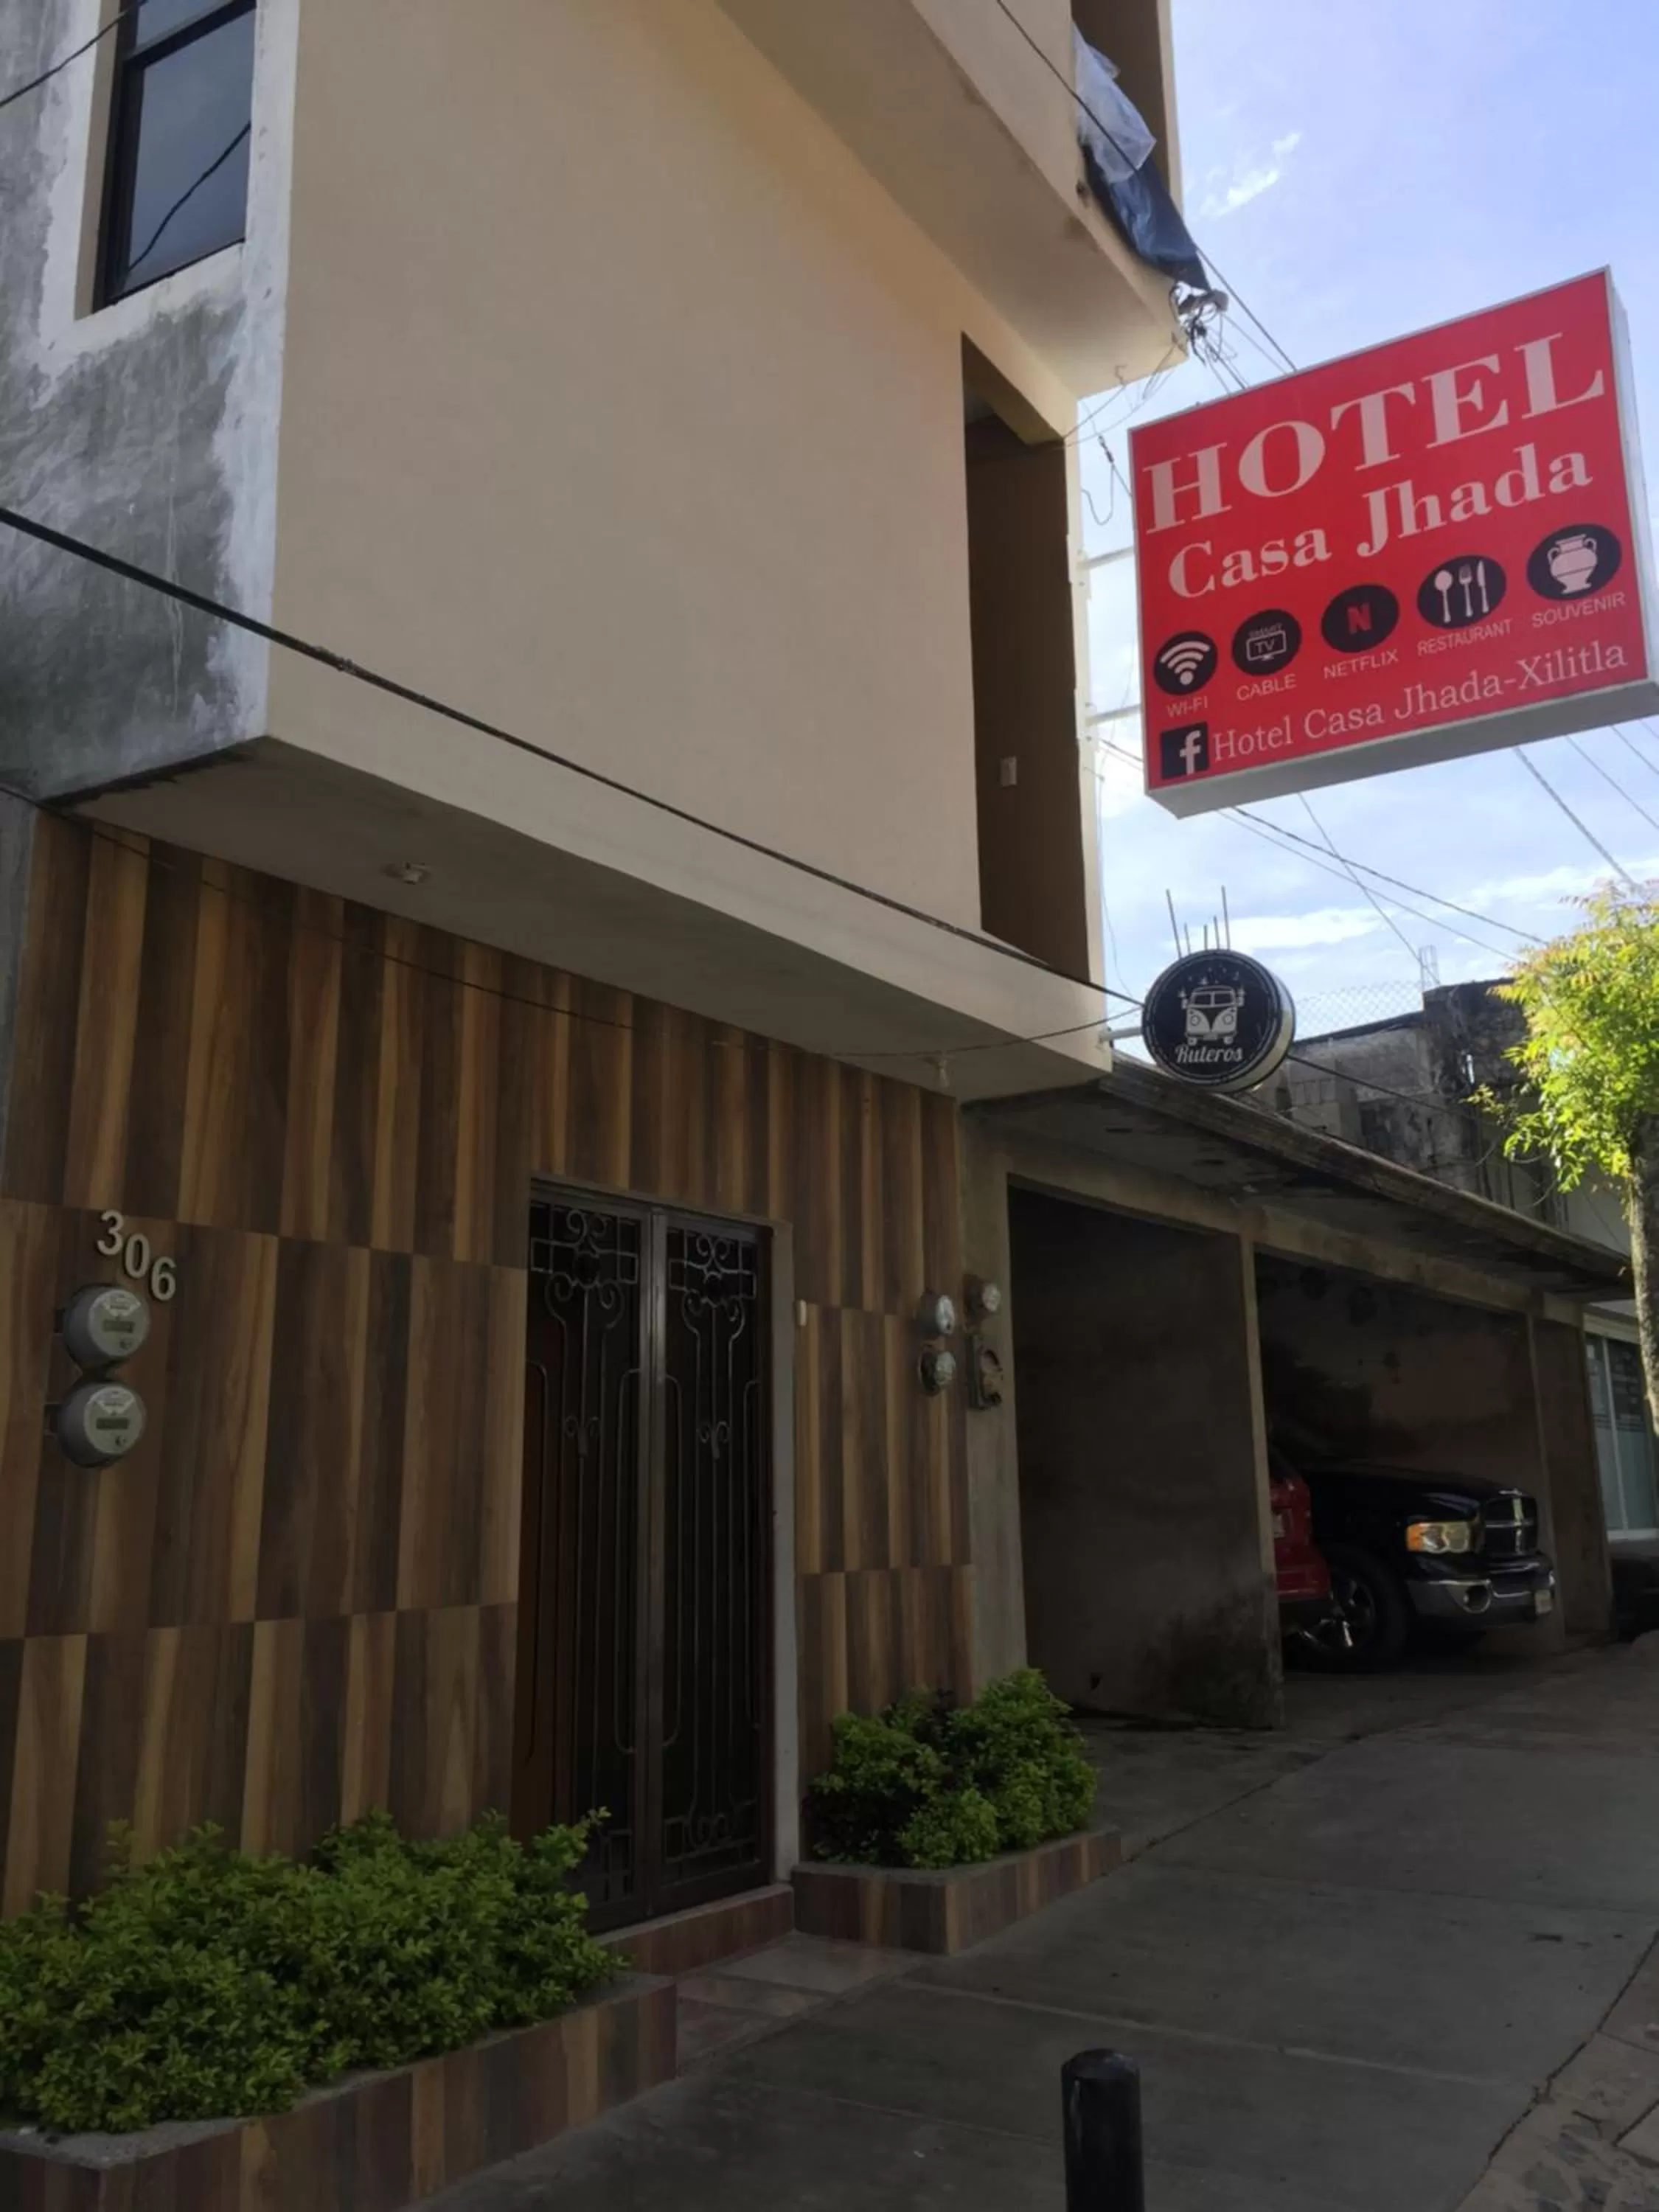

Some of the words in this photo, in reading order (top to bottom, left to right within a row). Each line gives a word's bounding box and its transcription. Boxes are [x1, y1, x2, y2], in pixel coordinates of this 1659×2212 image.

[1143, 332, 1604, 534] HOTEL
[1169, 529, 1332, 598] Casa
[1357, 443, 1593, 557] Jhada
[1347, 602, 1371, 635] N
[1532, 592, 1626, 628] SOUVENIR
[1253, 639, 1274, 654] TV
[1417, 619, 1512, 655] RESTAURANT
[1324, 649, 1399, 678] NETFLIX
[1214, 715, 1294, 762] Hotel
[1304, 703, 1385, 739] Casa
[1394, 640, 1628, 720] Jhada-Xilitla
[1237, 674, 1297, 700] CABLE
[1167, 696, 1208, 717] WI-FI
[97, 1210, 177, 1301] 306
